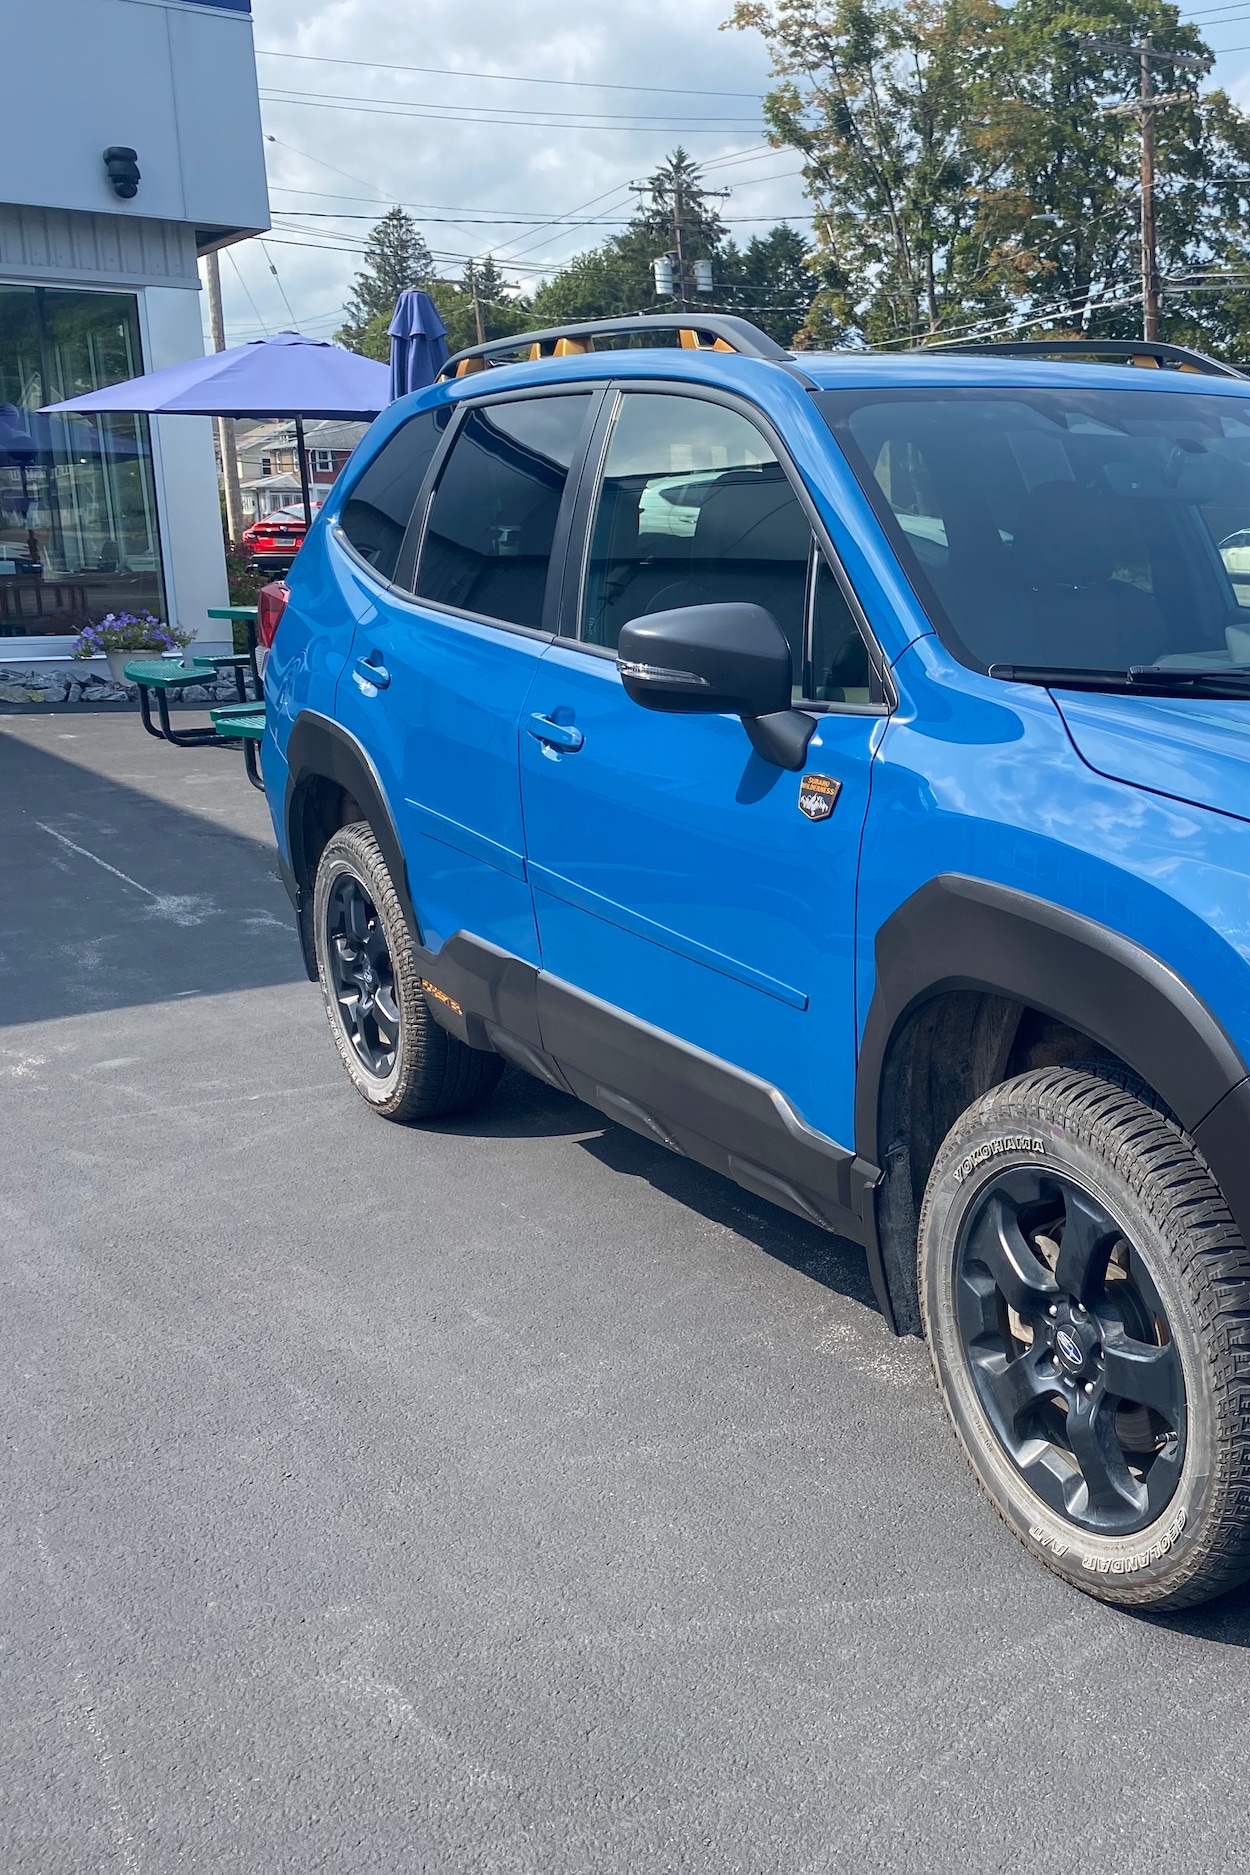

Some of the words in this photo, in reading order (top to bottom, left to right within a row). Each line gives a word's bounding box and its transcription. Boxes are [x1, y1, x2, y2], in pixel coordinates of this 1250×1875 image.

[802, 782, 835, 796] WILDERNESS
[808, 777, 830, 787] SUBARU
[952, 1135, 1045, 1183] YOKOHAMA
[1028, 1525, 1070, 1557] A/T
[1081, 1505, 1187, 1575] GEOLANDAR
